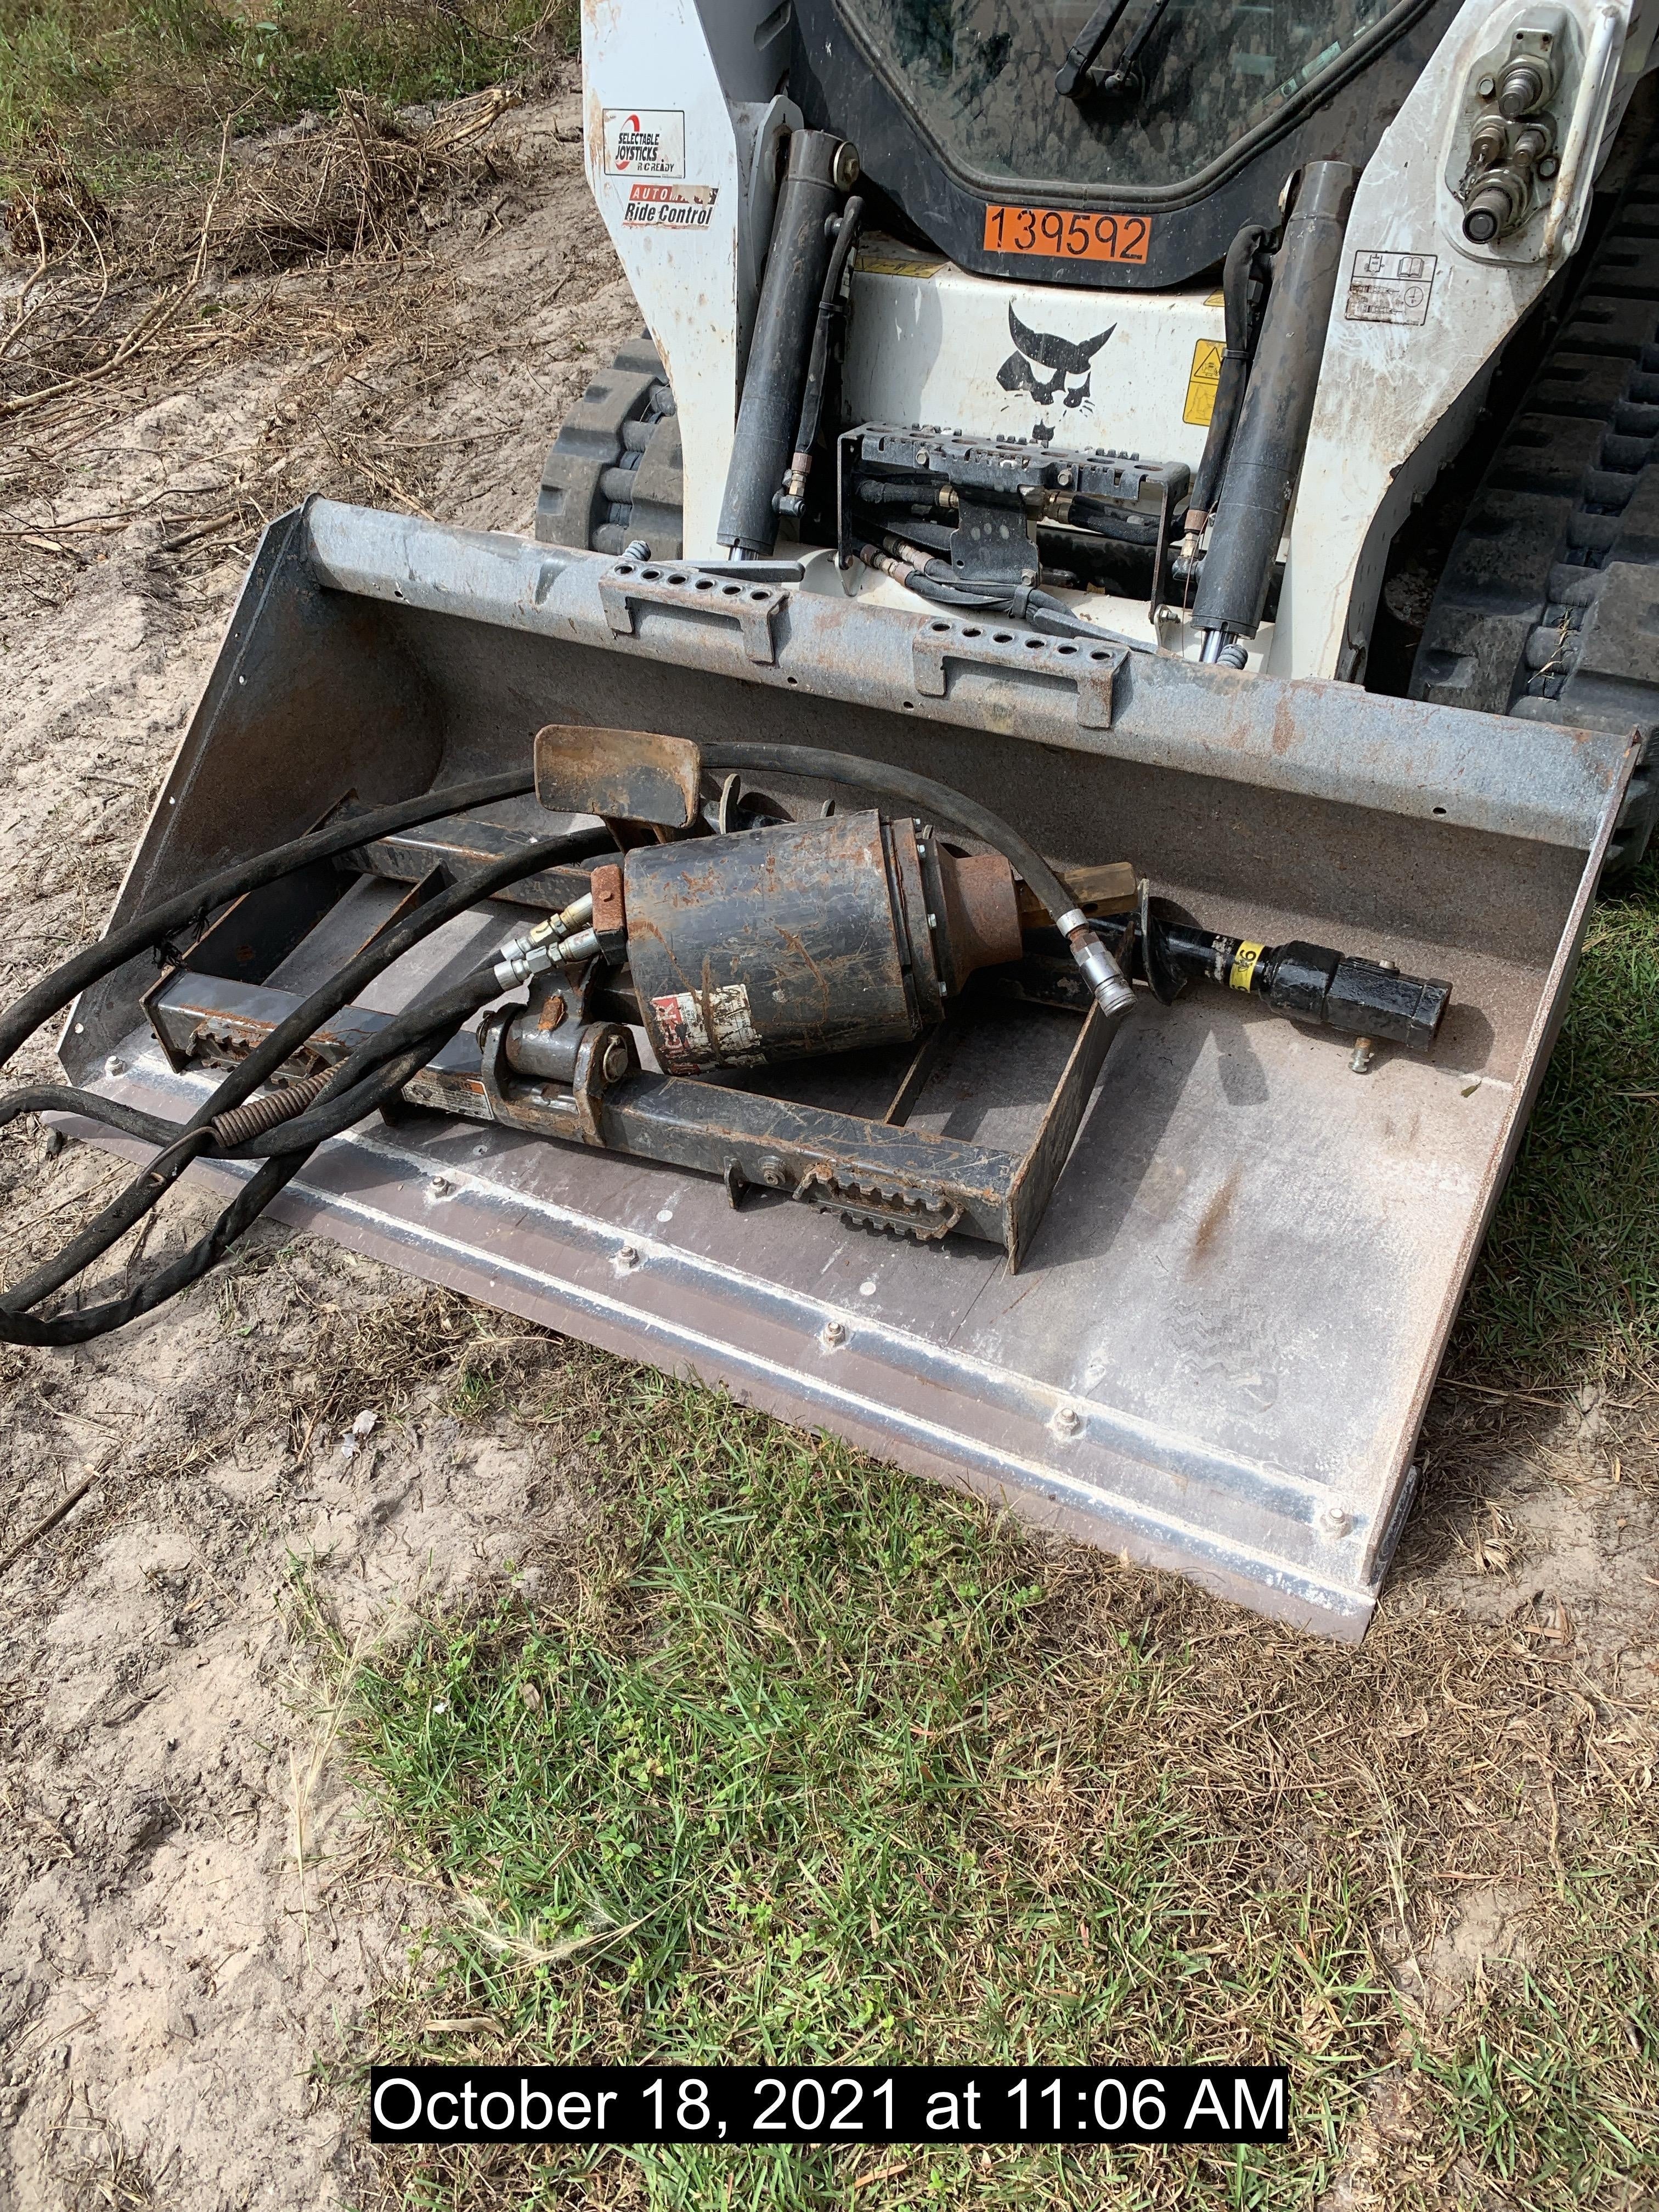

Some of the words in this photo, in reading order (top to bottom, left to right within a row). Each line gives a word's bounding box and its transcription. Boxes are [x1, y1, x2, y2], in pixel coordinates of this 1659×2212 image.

[618, 133, 659, 145] SELECTABLE
[615, 145, 658, 161] JOYSTICKS
[625, 202, 656, 221] Ride
[659, 205, 713, 224] Control
[992, 208, 1146, 259] 139592
